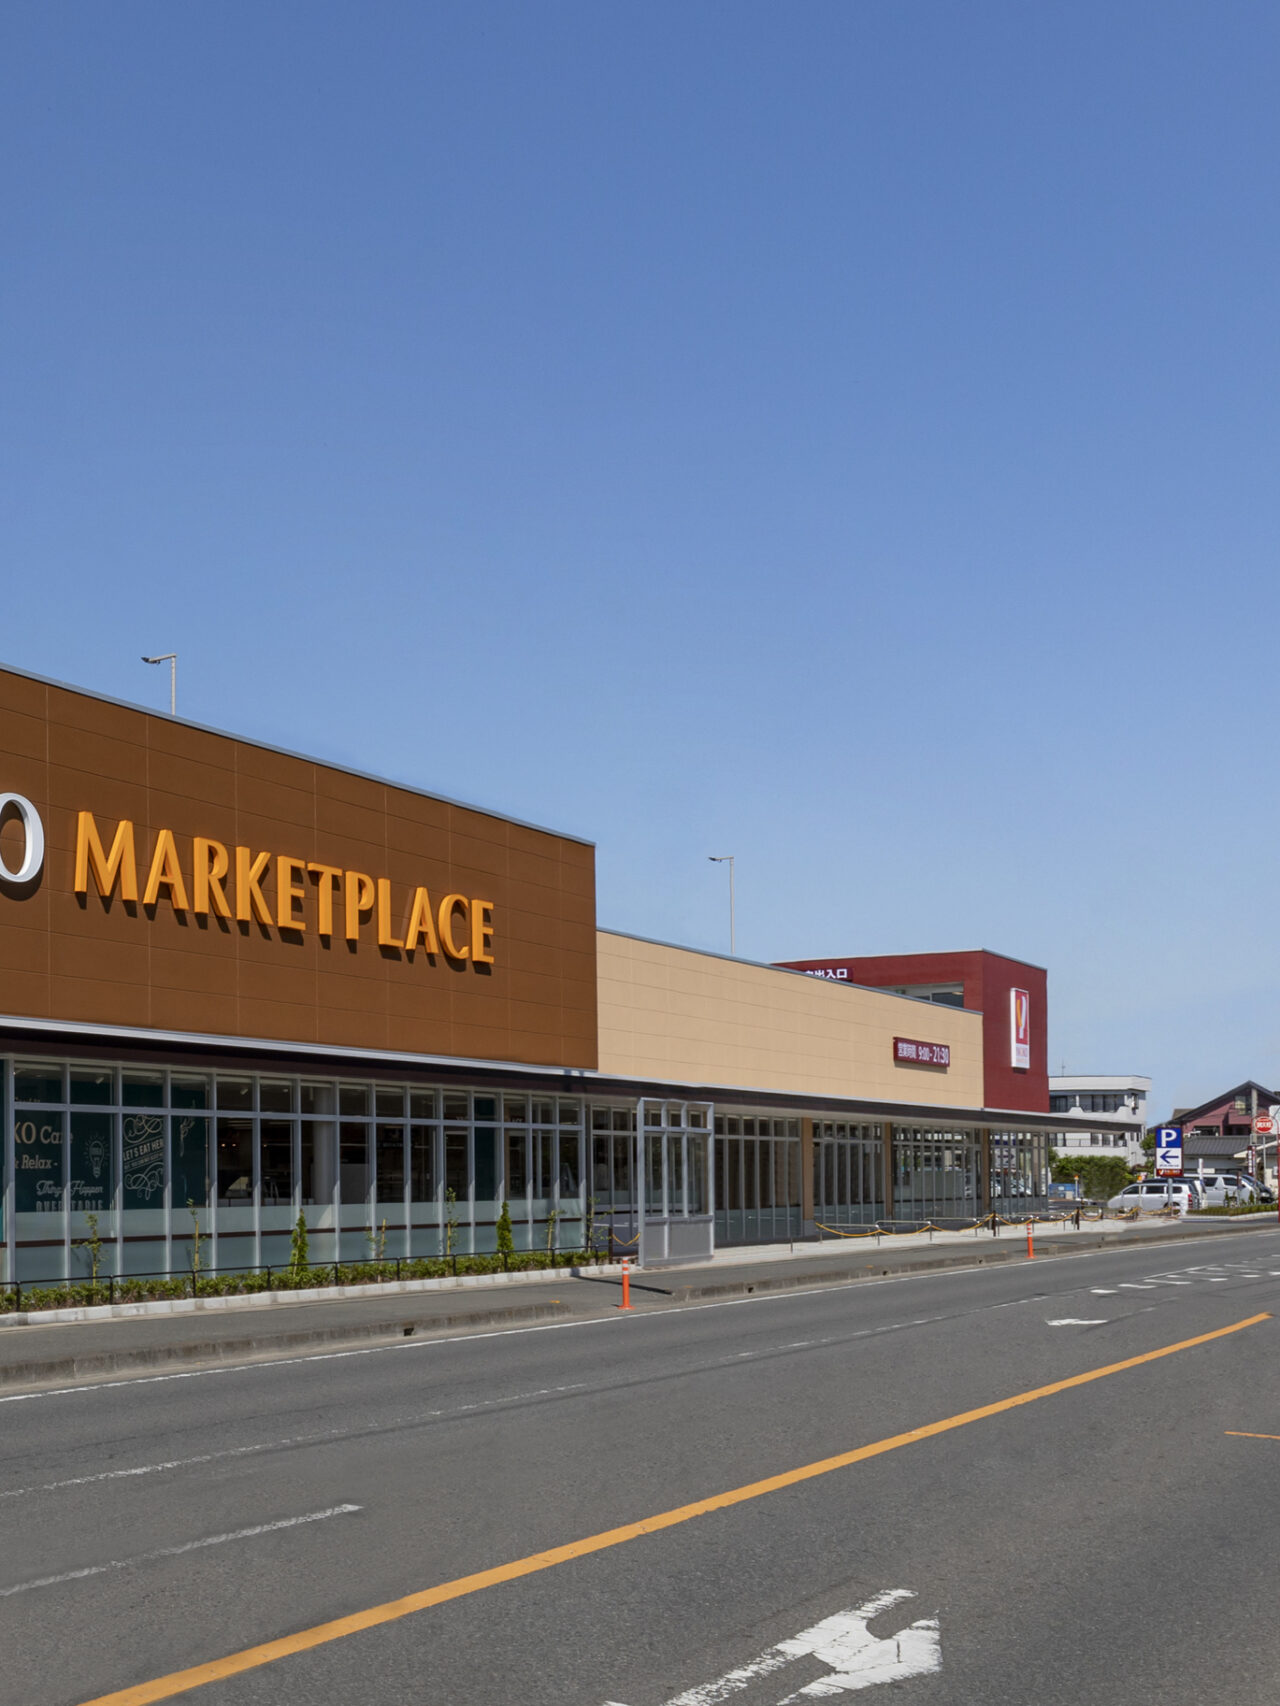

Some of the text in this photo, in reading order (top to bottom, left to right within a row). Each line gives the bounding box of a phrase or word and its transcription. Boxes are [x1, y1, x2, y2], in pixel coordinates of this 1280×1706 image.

[74, 811, 495, 964] MARKETPLACE
[40, 1125, 74, 1145] Ca
[1161, 1129, 1177, 1147] P
[21, 1154, 52, 1169] Relax
[36, 1180, 63, 1198] Thing
